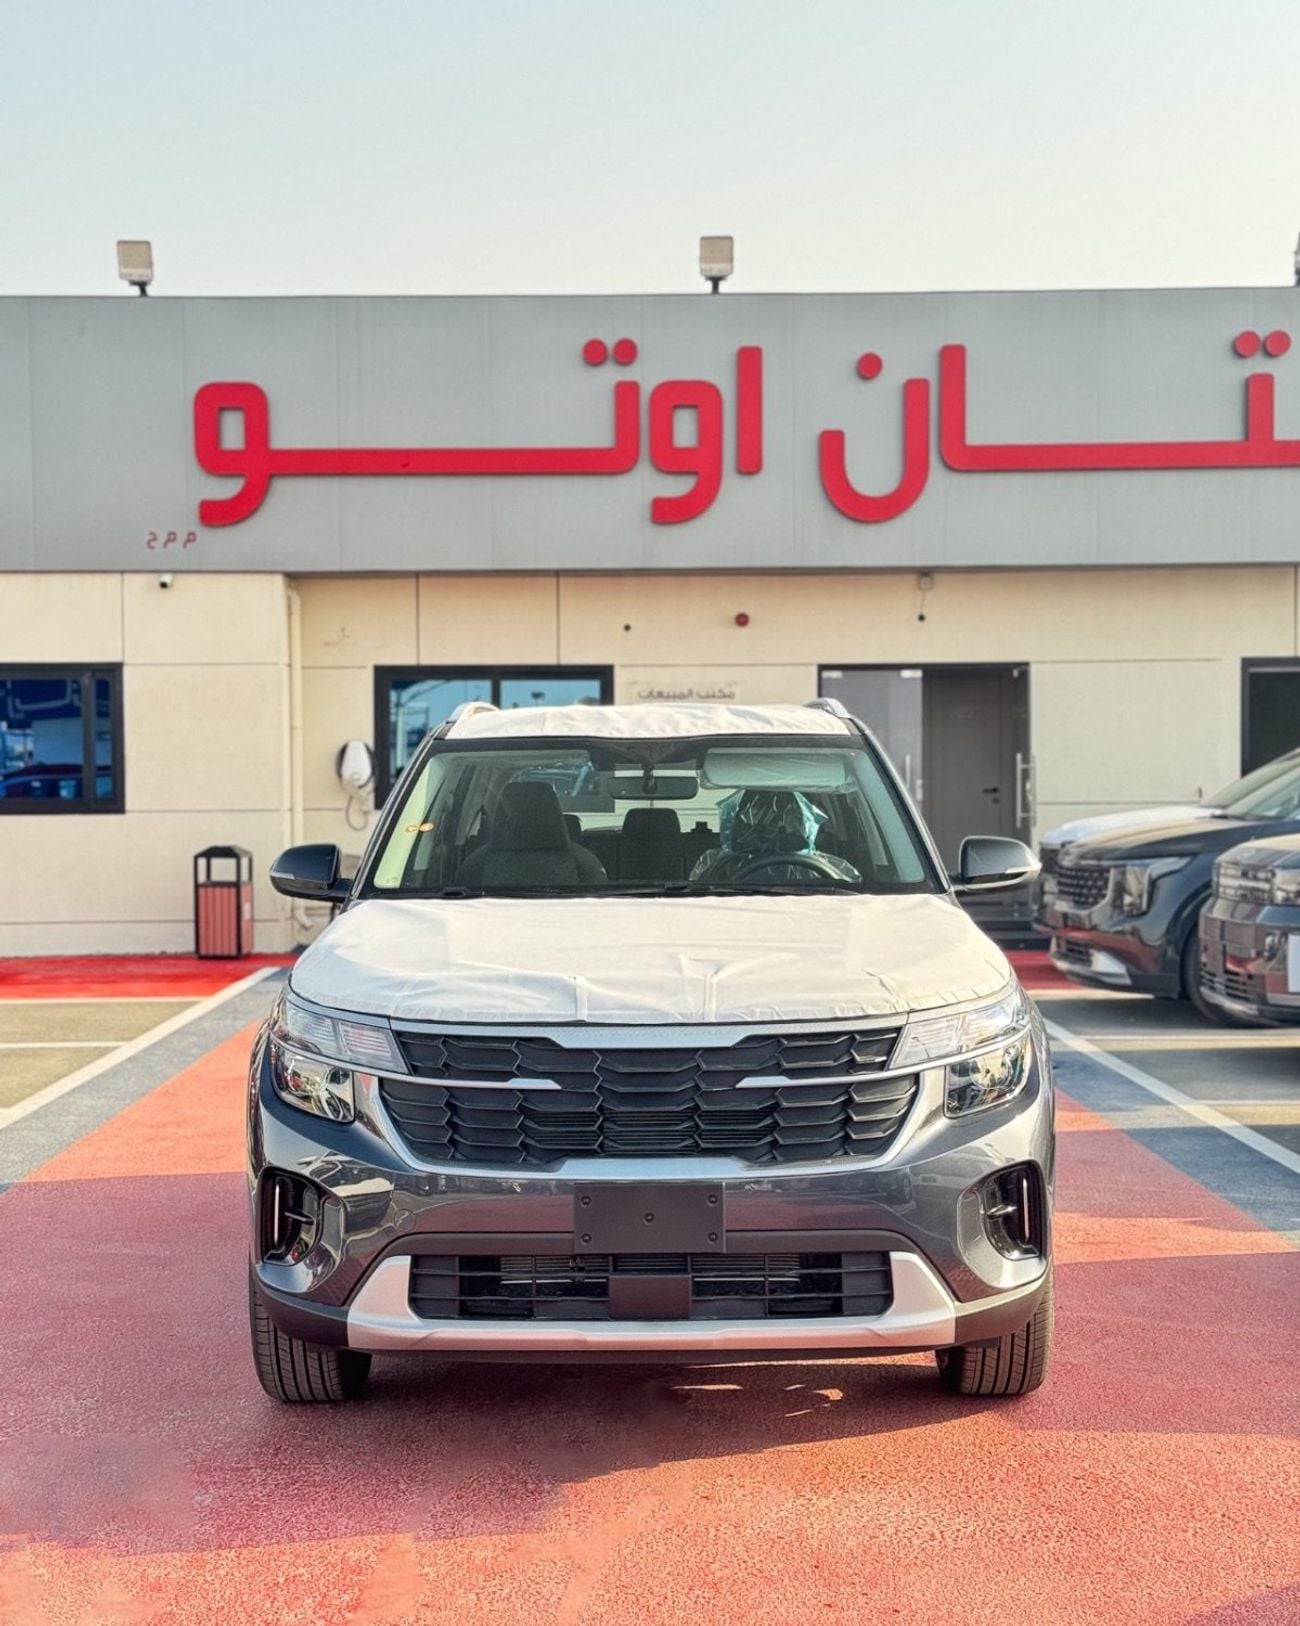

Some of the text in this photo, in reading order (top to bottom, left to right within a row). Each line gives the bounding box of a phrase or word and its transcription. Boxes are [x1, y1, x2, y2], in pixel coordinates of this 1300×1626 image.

[194, 331, 1300, 527] تان اوتو
[637, 687, 737, 700] مكتب المبيعات
